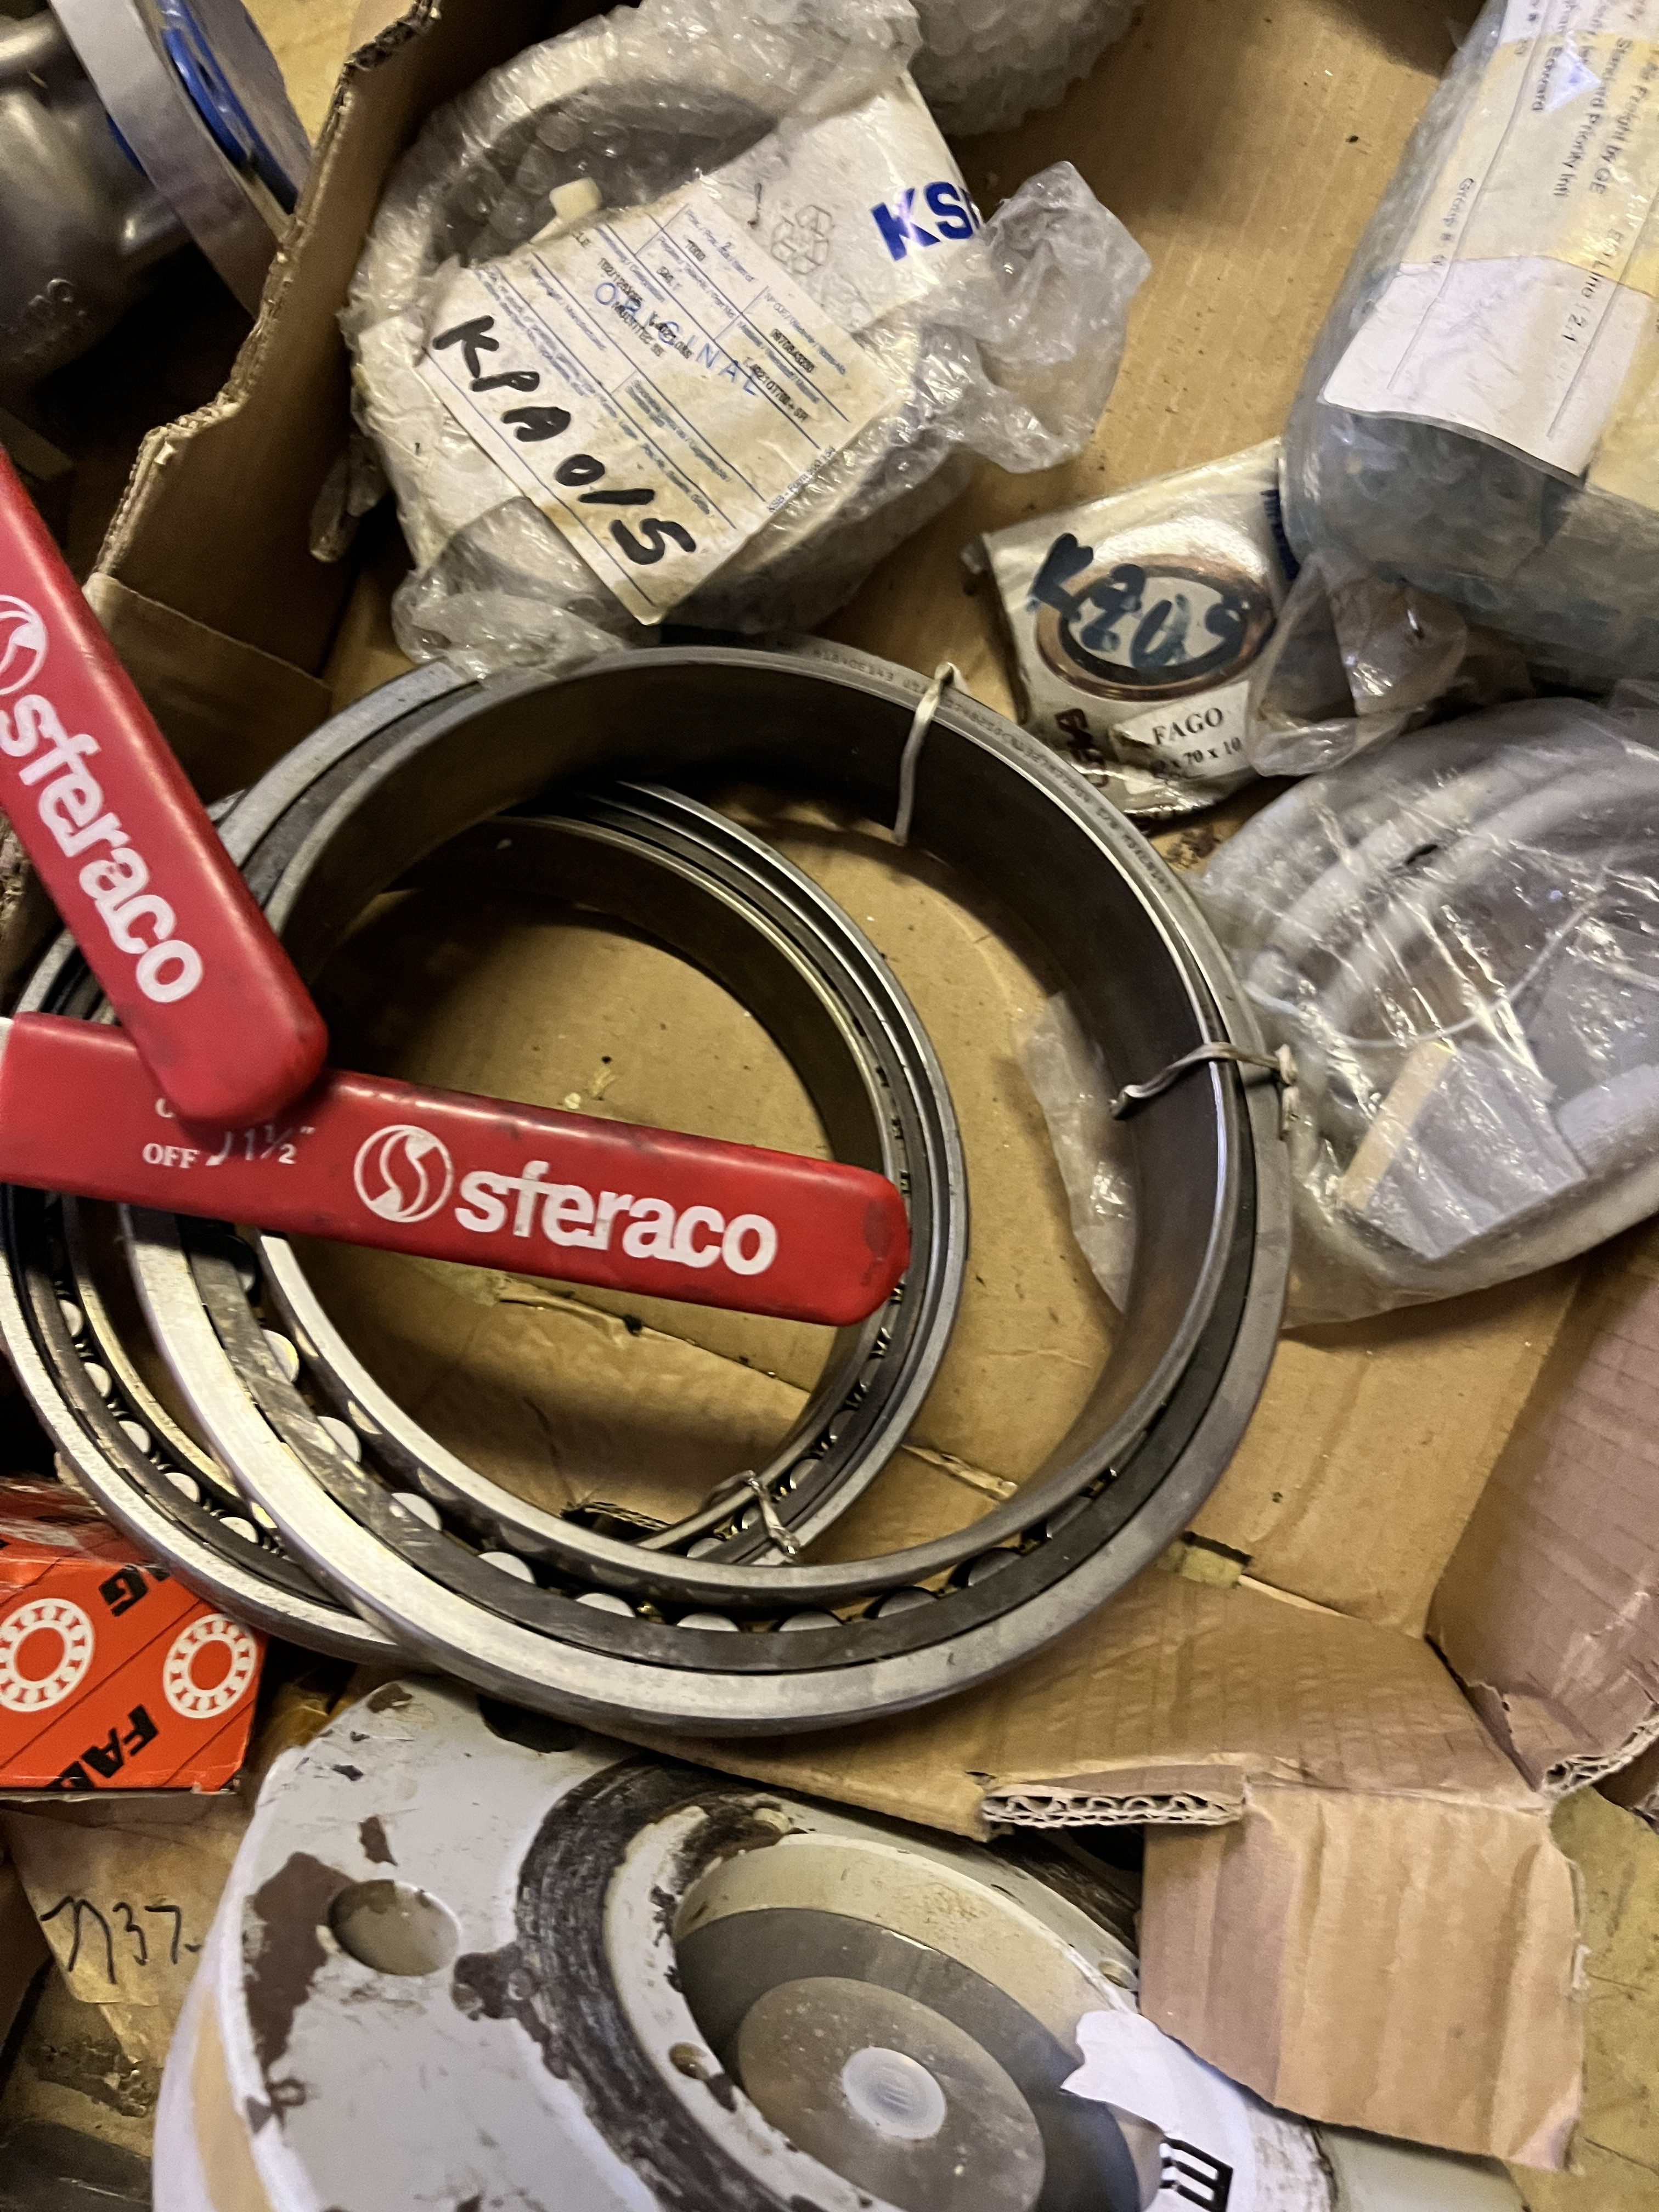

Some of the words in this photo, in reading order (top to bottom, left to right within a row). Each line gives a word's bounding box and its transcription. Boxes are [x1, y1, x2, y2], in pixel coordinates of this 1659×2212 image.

[1590, 37, 1633, 107] Standard
[1562, 113, 1601, 169] Priority
[871, 180, 985, 262] KS
[1152, 707, 1224, 746] FAGO
[0, 695, 203, 1003] sferaco
[142, 1142, 201, 1169] OFF
[456, 1160, 777, 1276] sferaco
